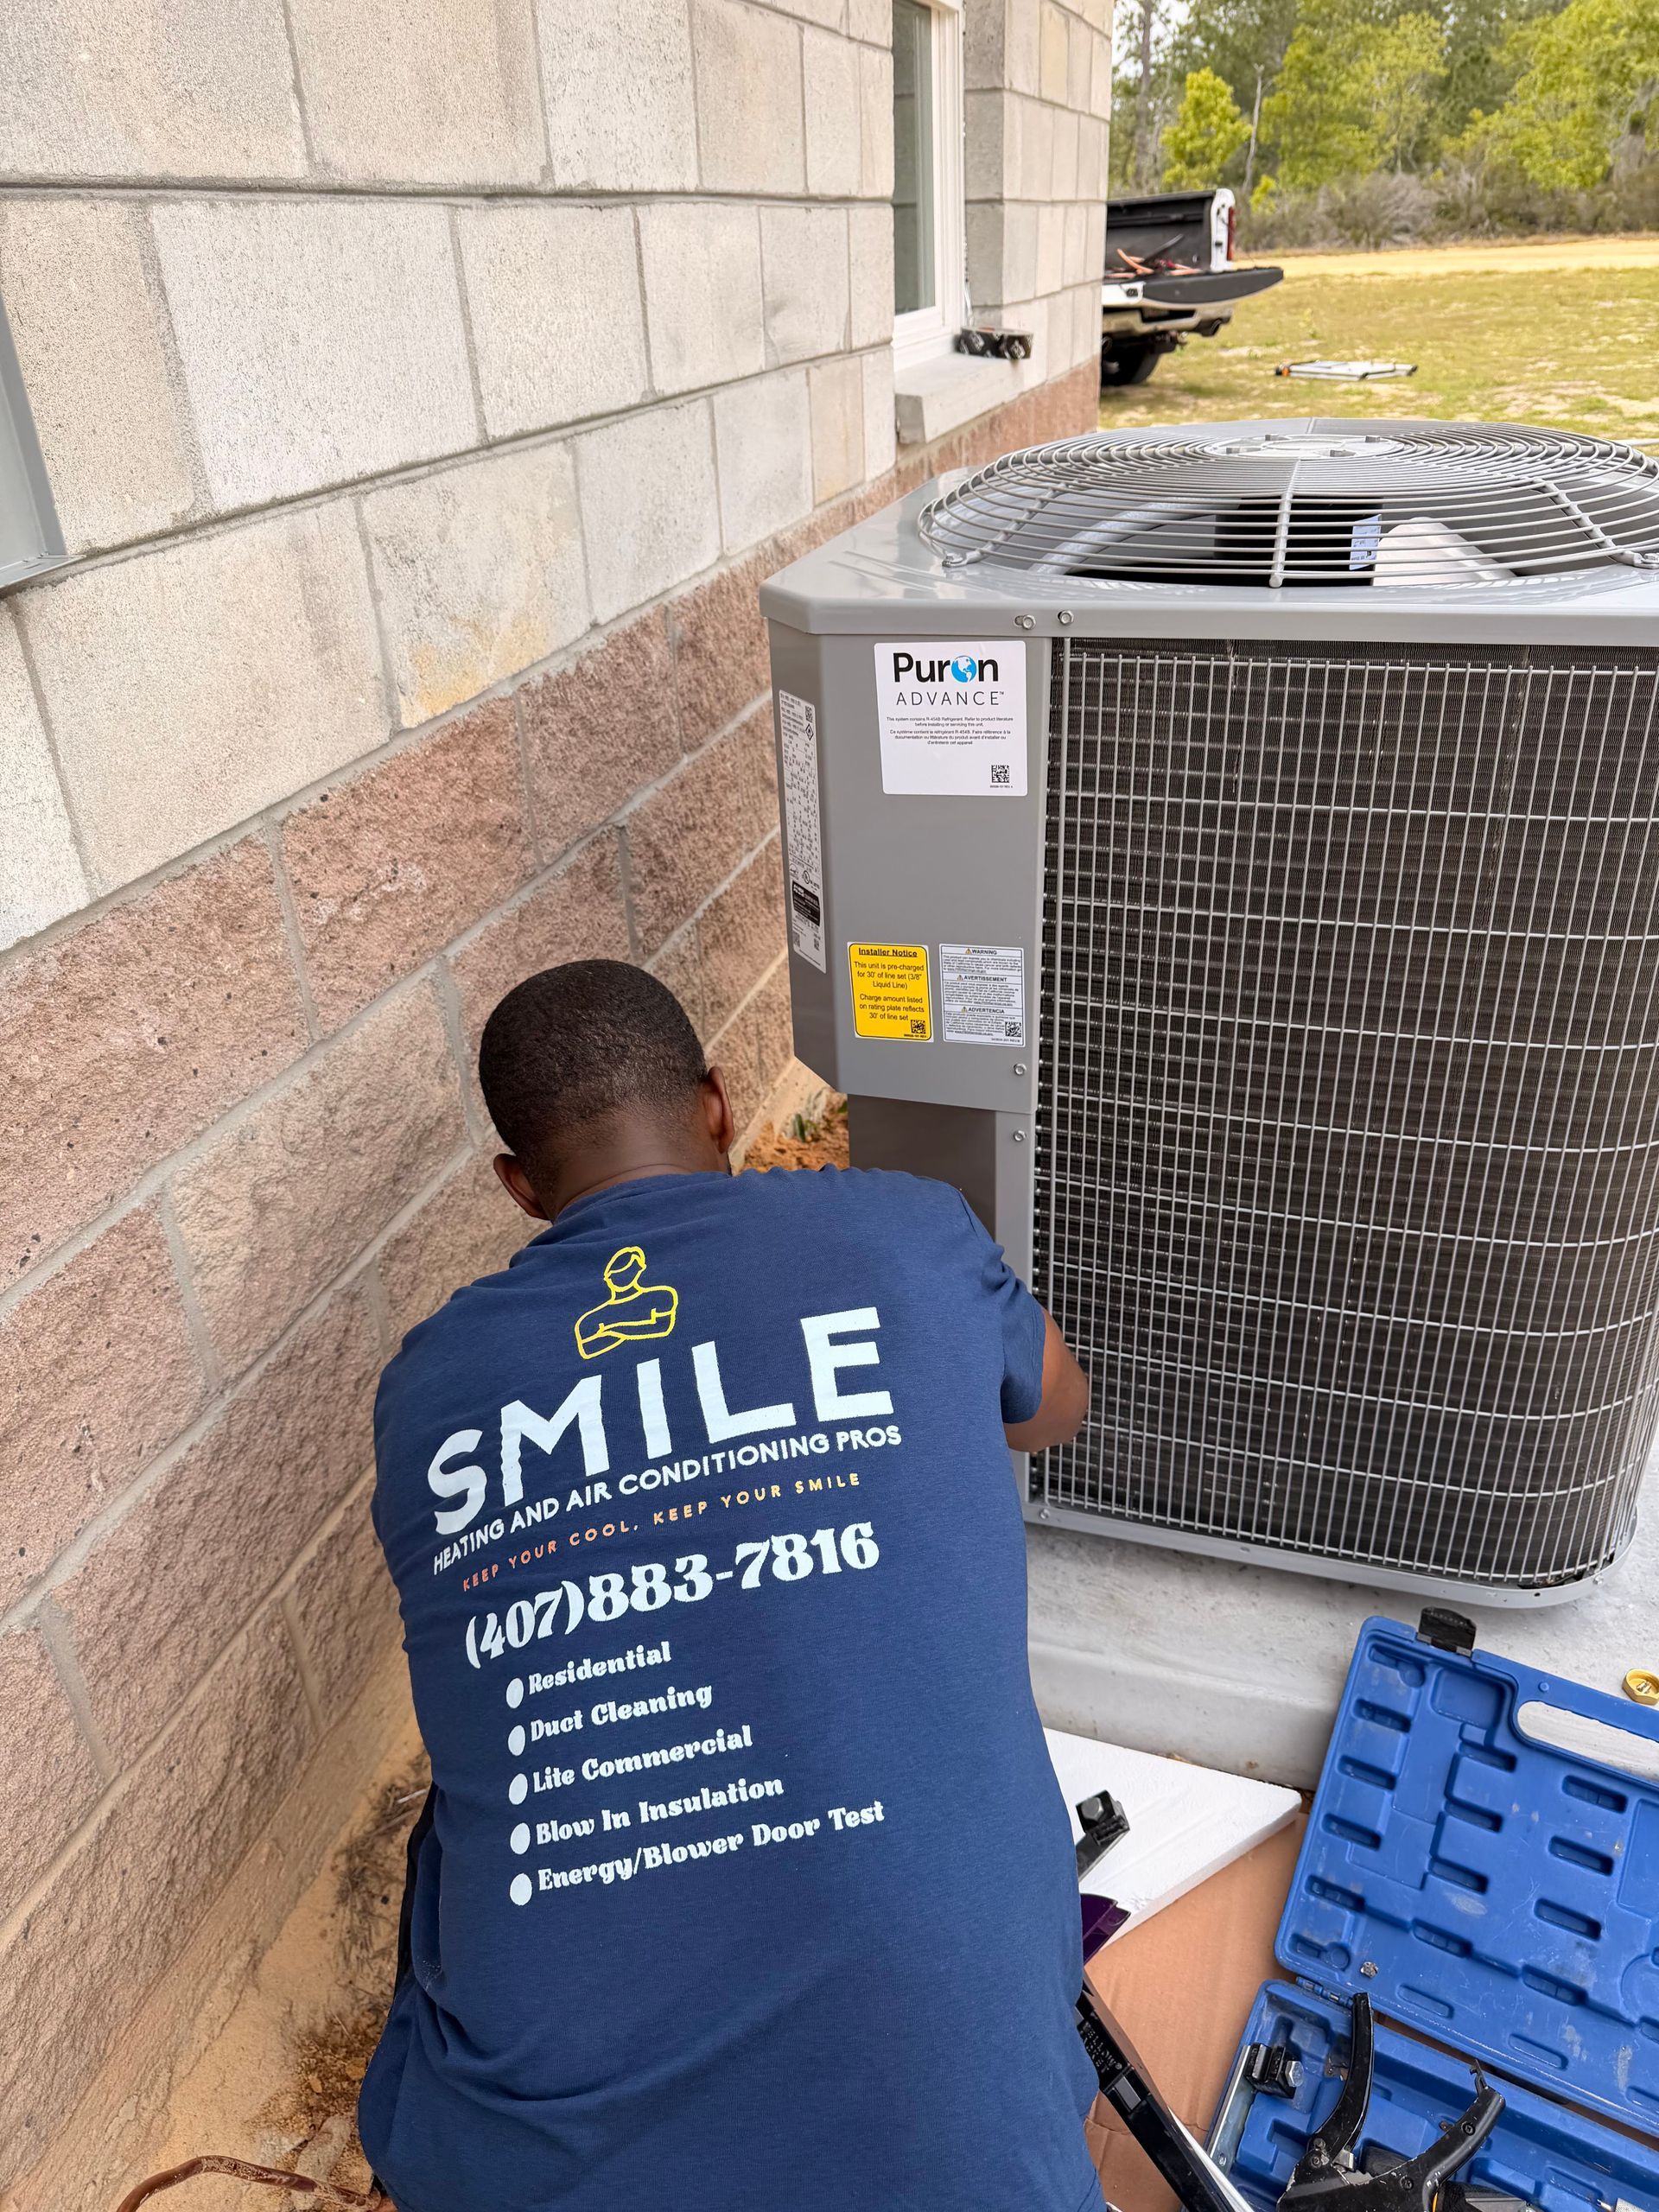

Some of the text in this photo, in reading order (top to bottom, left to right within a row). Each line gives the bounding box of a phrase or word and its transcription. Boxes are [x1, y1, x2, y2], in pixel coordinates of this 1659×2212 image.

[893, 652, 999, 683] Puron
[859, 948, 890, 957] Installer
[887, 963, 924, 972] pre-charged
[860, 994, 881, 1002] Charge
[427, 1307, 894, 1535] SMILE
[434, 1425, 902, 1575] HEATING AND AIR CONDITIONING PROS
[463, 1472, 860, 1592] KEEP YOUR COOL, KEEP YOUR SMILE
[465, 1522, 880, 1669] (407)883-7816
[528, 1641, 671, 1695] Residential
[531, 1683, 712, 1742] Duct Cleaning
[533, 1726, 753, 1793] Lite Commercial
[536, 1777, 784, 1846] Blow In Insulation
[537, 1800, 885, 1891] Energy/Blower Door Test
